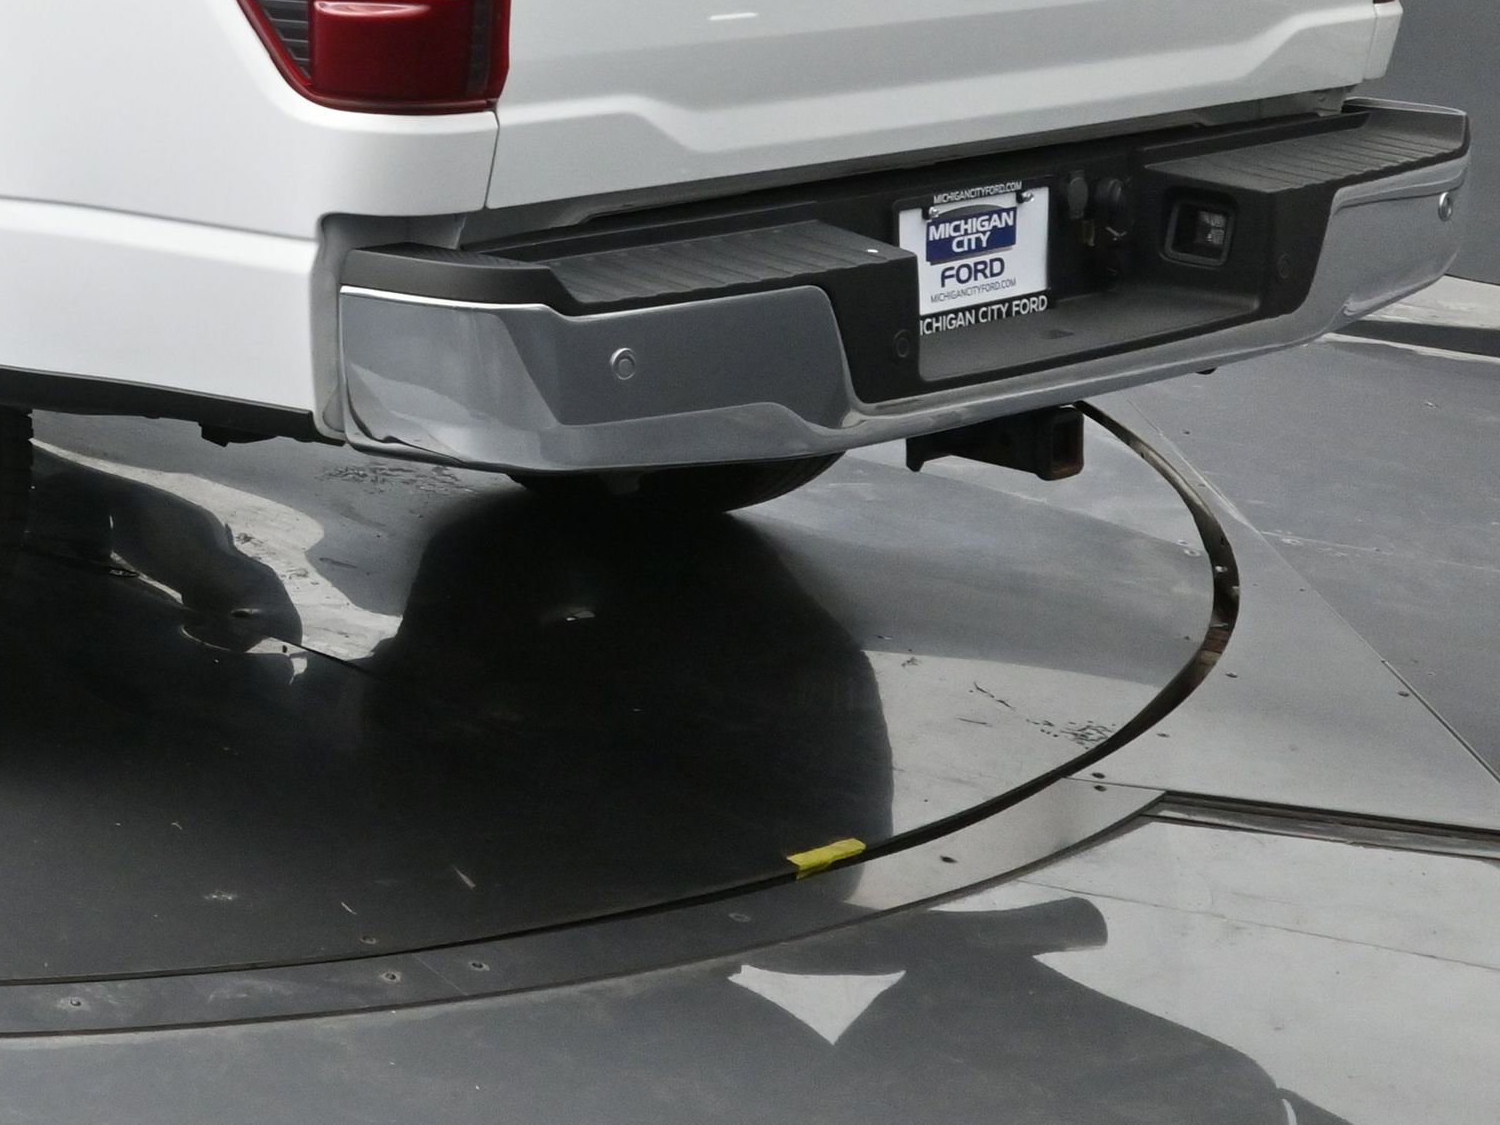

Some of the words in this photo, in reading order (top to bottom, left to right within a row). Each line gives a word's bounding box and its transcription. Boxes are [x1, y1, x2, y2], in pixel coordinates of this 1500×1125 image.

[933, 181, 1022, 204] MICHIGANCITYFORD.COM
[929, 211, 1014, 241] MICHIGAN
[952, 232, 991, 253] CITY
[941, 257, 1005, 288] FORD
[930, 277, 1017, 303] MICHIGANCITYFORD.COM
[919, 309, 975, 336] ICHIGAN
[978, 303, 1009, 323] CITY
[1012, 295, 1048, 317] FORD
